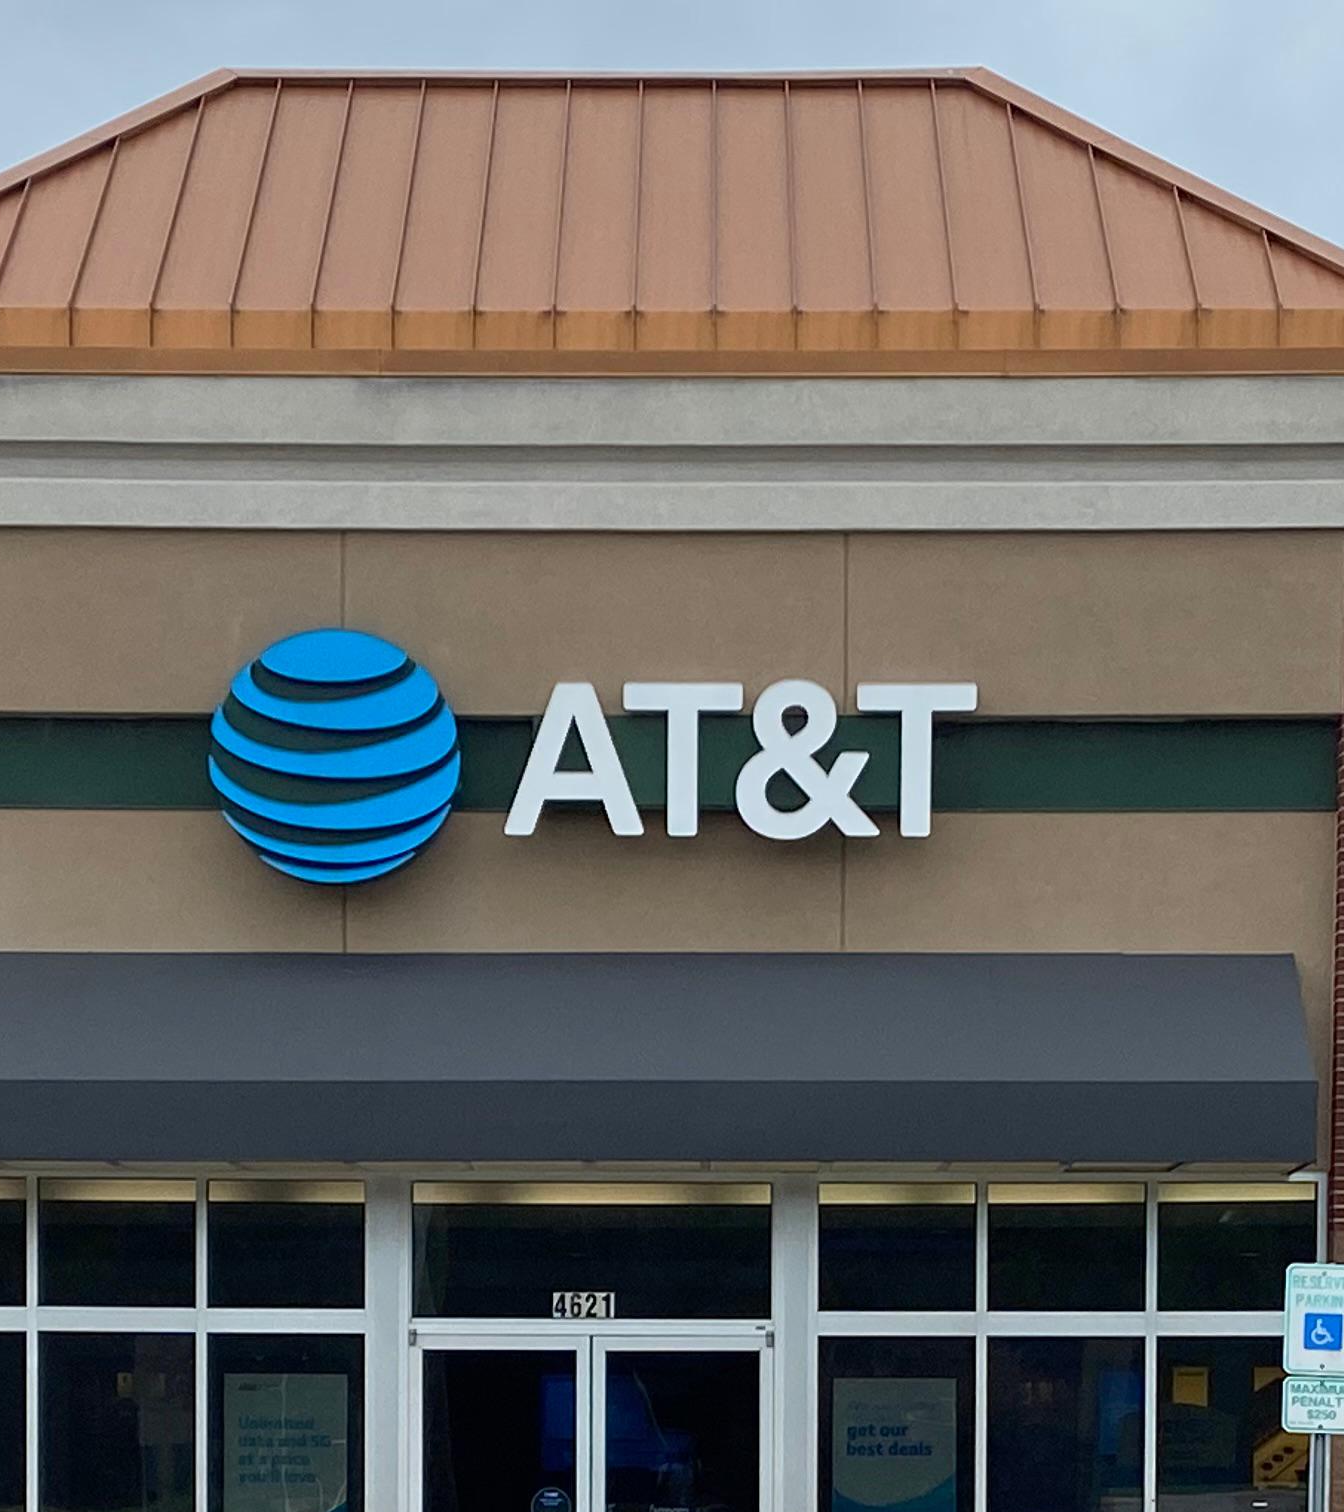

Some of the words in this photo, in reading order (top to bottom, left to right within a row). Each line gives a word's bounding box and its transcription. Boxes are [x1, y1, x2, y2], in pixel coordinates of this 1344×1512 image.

[504, 679, 978, 841] AT&T
[554, 1292, 611, 1319] 4621
[1307, 1409, 1337, 1421] $250
[880, 1426, 908, 1437] our
[847, 1441, 883, 1456] best
[888, 1441, 933, 1456] deals
